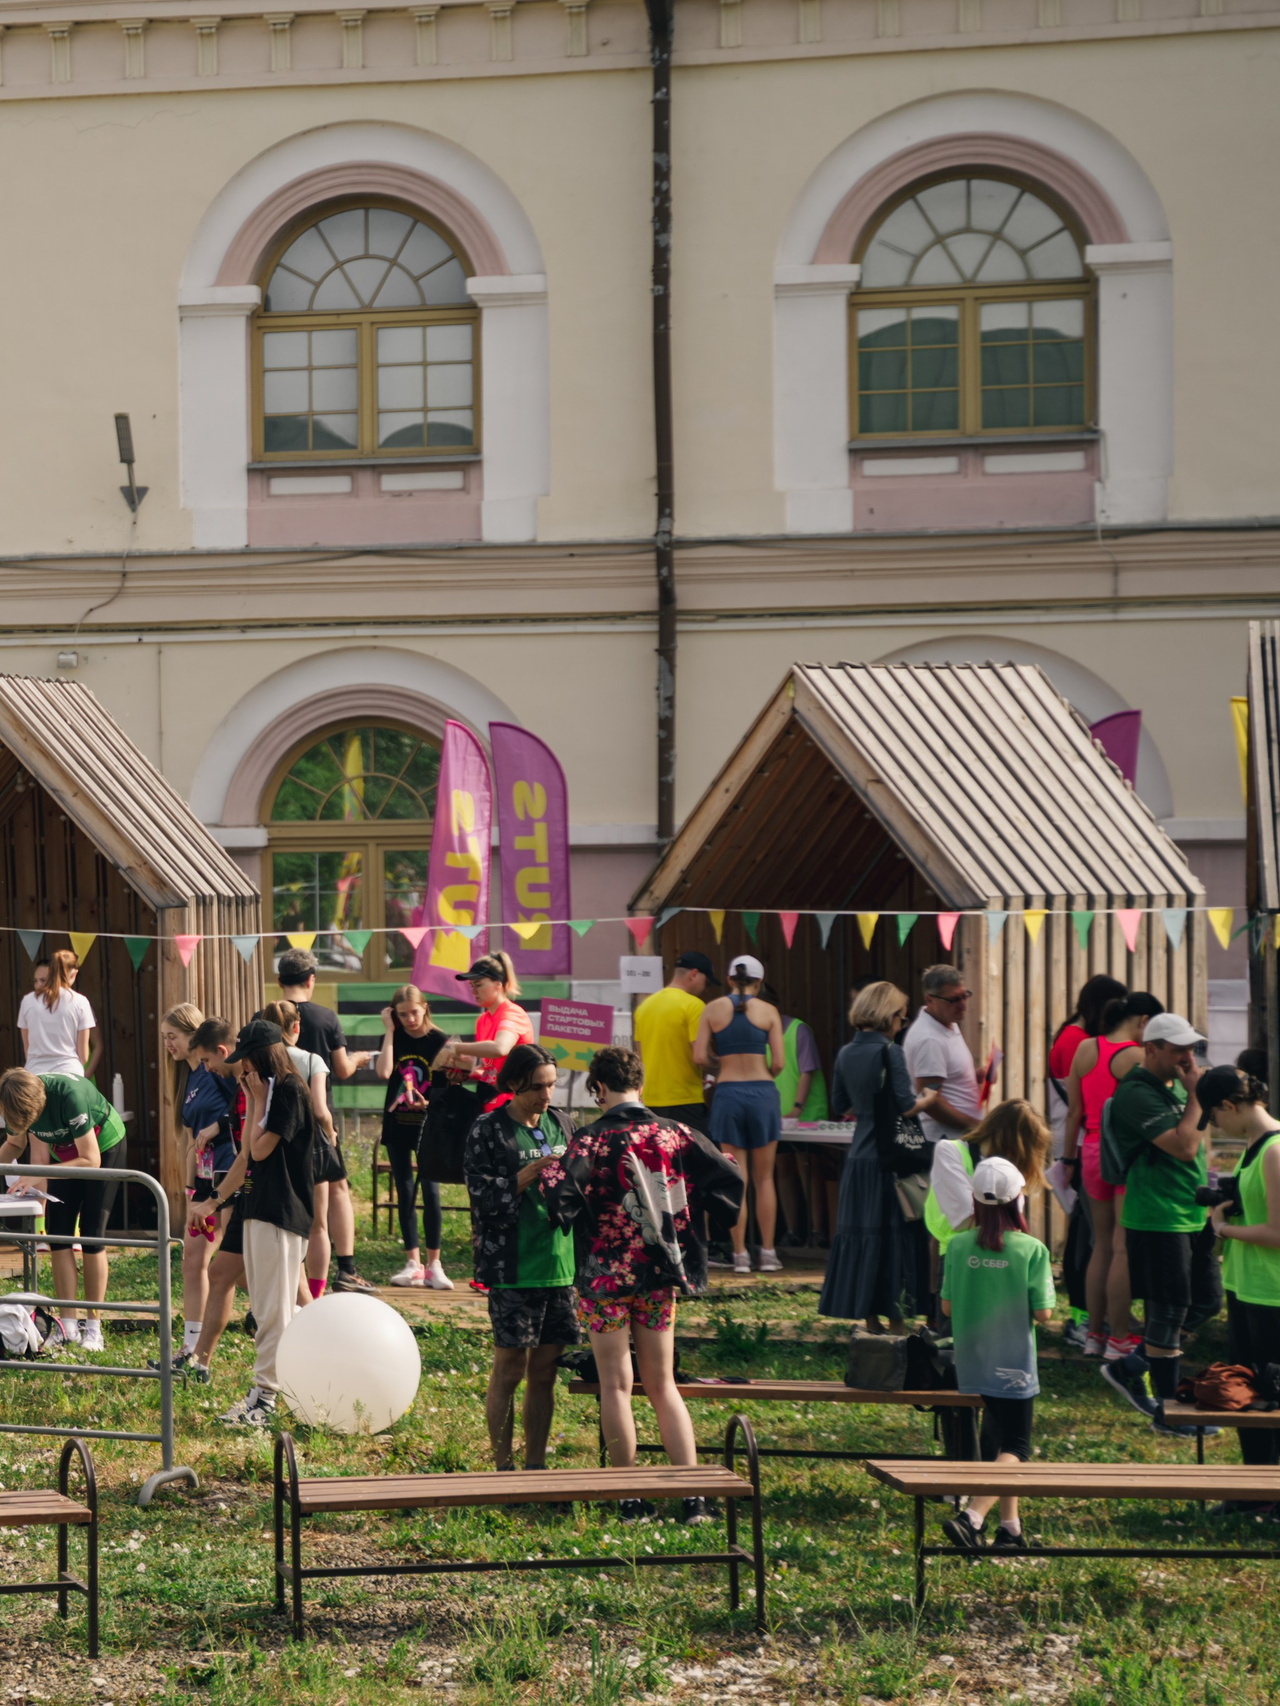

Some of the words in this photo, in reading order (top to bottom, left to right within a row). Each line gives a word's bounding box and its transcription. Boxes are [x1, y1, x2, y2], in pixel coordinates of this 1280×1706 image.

[548, 1004, 588, 1016] ВЫДАЧА
[547, 1013, 605, 1028] СТАРТОВЫХ
[546, 1023, 591, 1036] ПАКЕТОВ
[982, 1259, 1009, 1269] СБЕР
